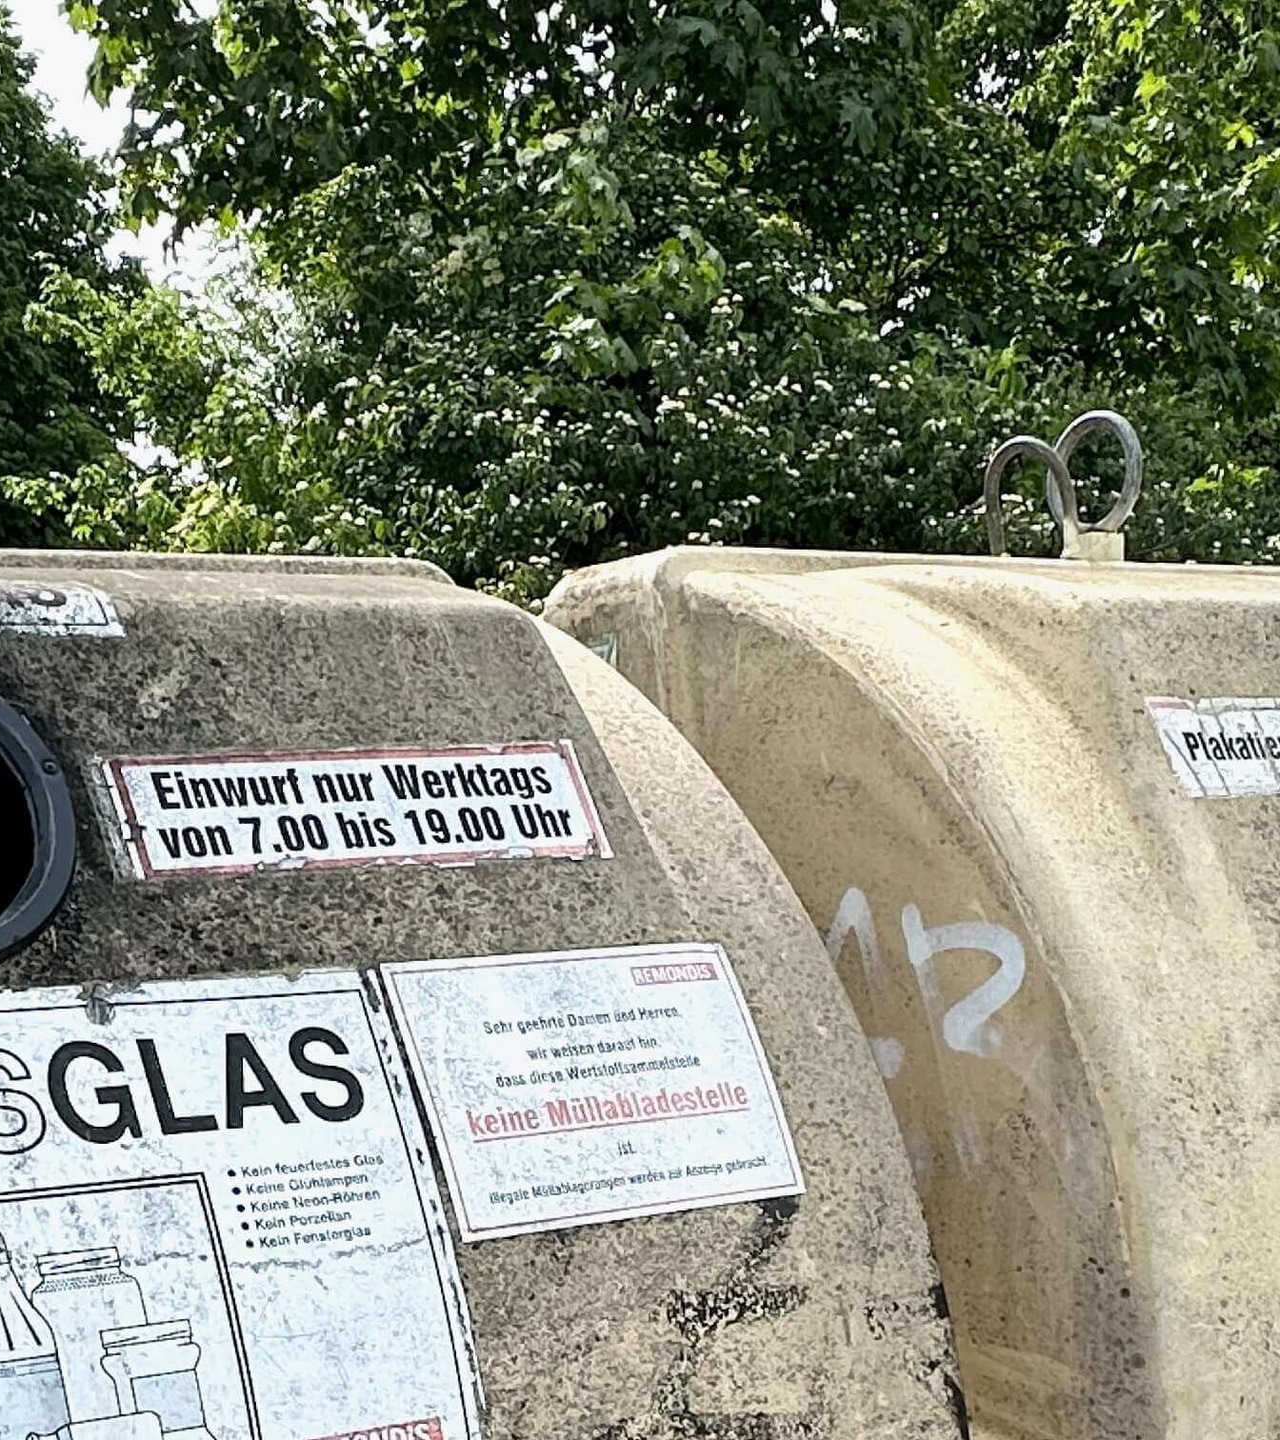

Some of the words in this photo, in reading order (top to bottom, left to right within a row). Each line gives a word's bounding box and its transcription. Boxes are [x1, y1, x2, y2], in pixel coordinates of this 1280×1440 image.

[150, 768, 306, 811] Einwurf
[312, 771, 375, 803] nur
[380, 762, 554, 800] Werktags
[158, 824, 235, 860] von
[238, 813, 330, 855] 7.00
[334, 810, 398, 849] bis
[403, 807, 506, 845] 19.00
[509, 802, 572, 840] Uhr
[632, 964, 712, 985] REMONDIS
[466, 1105, 541, 1136] keine
[543, 1081, 749, 1131] Müllabladestelle
